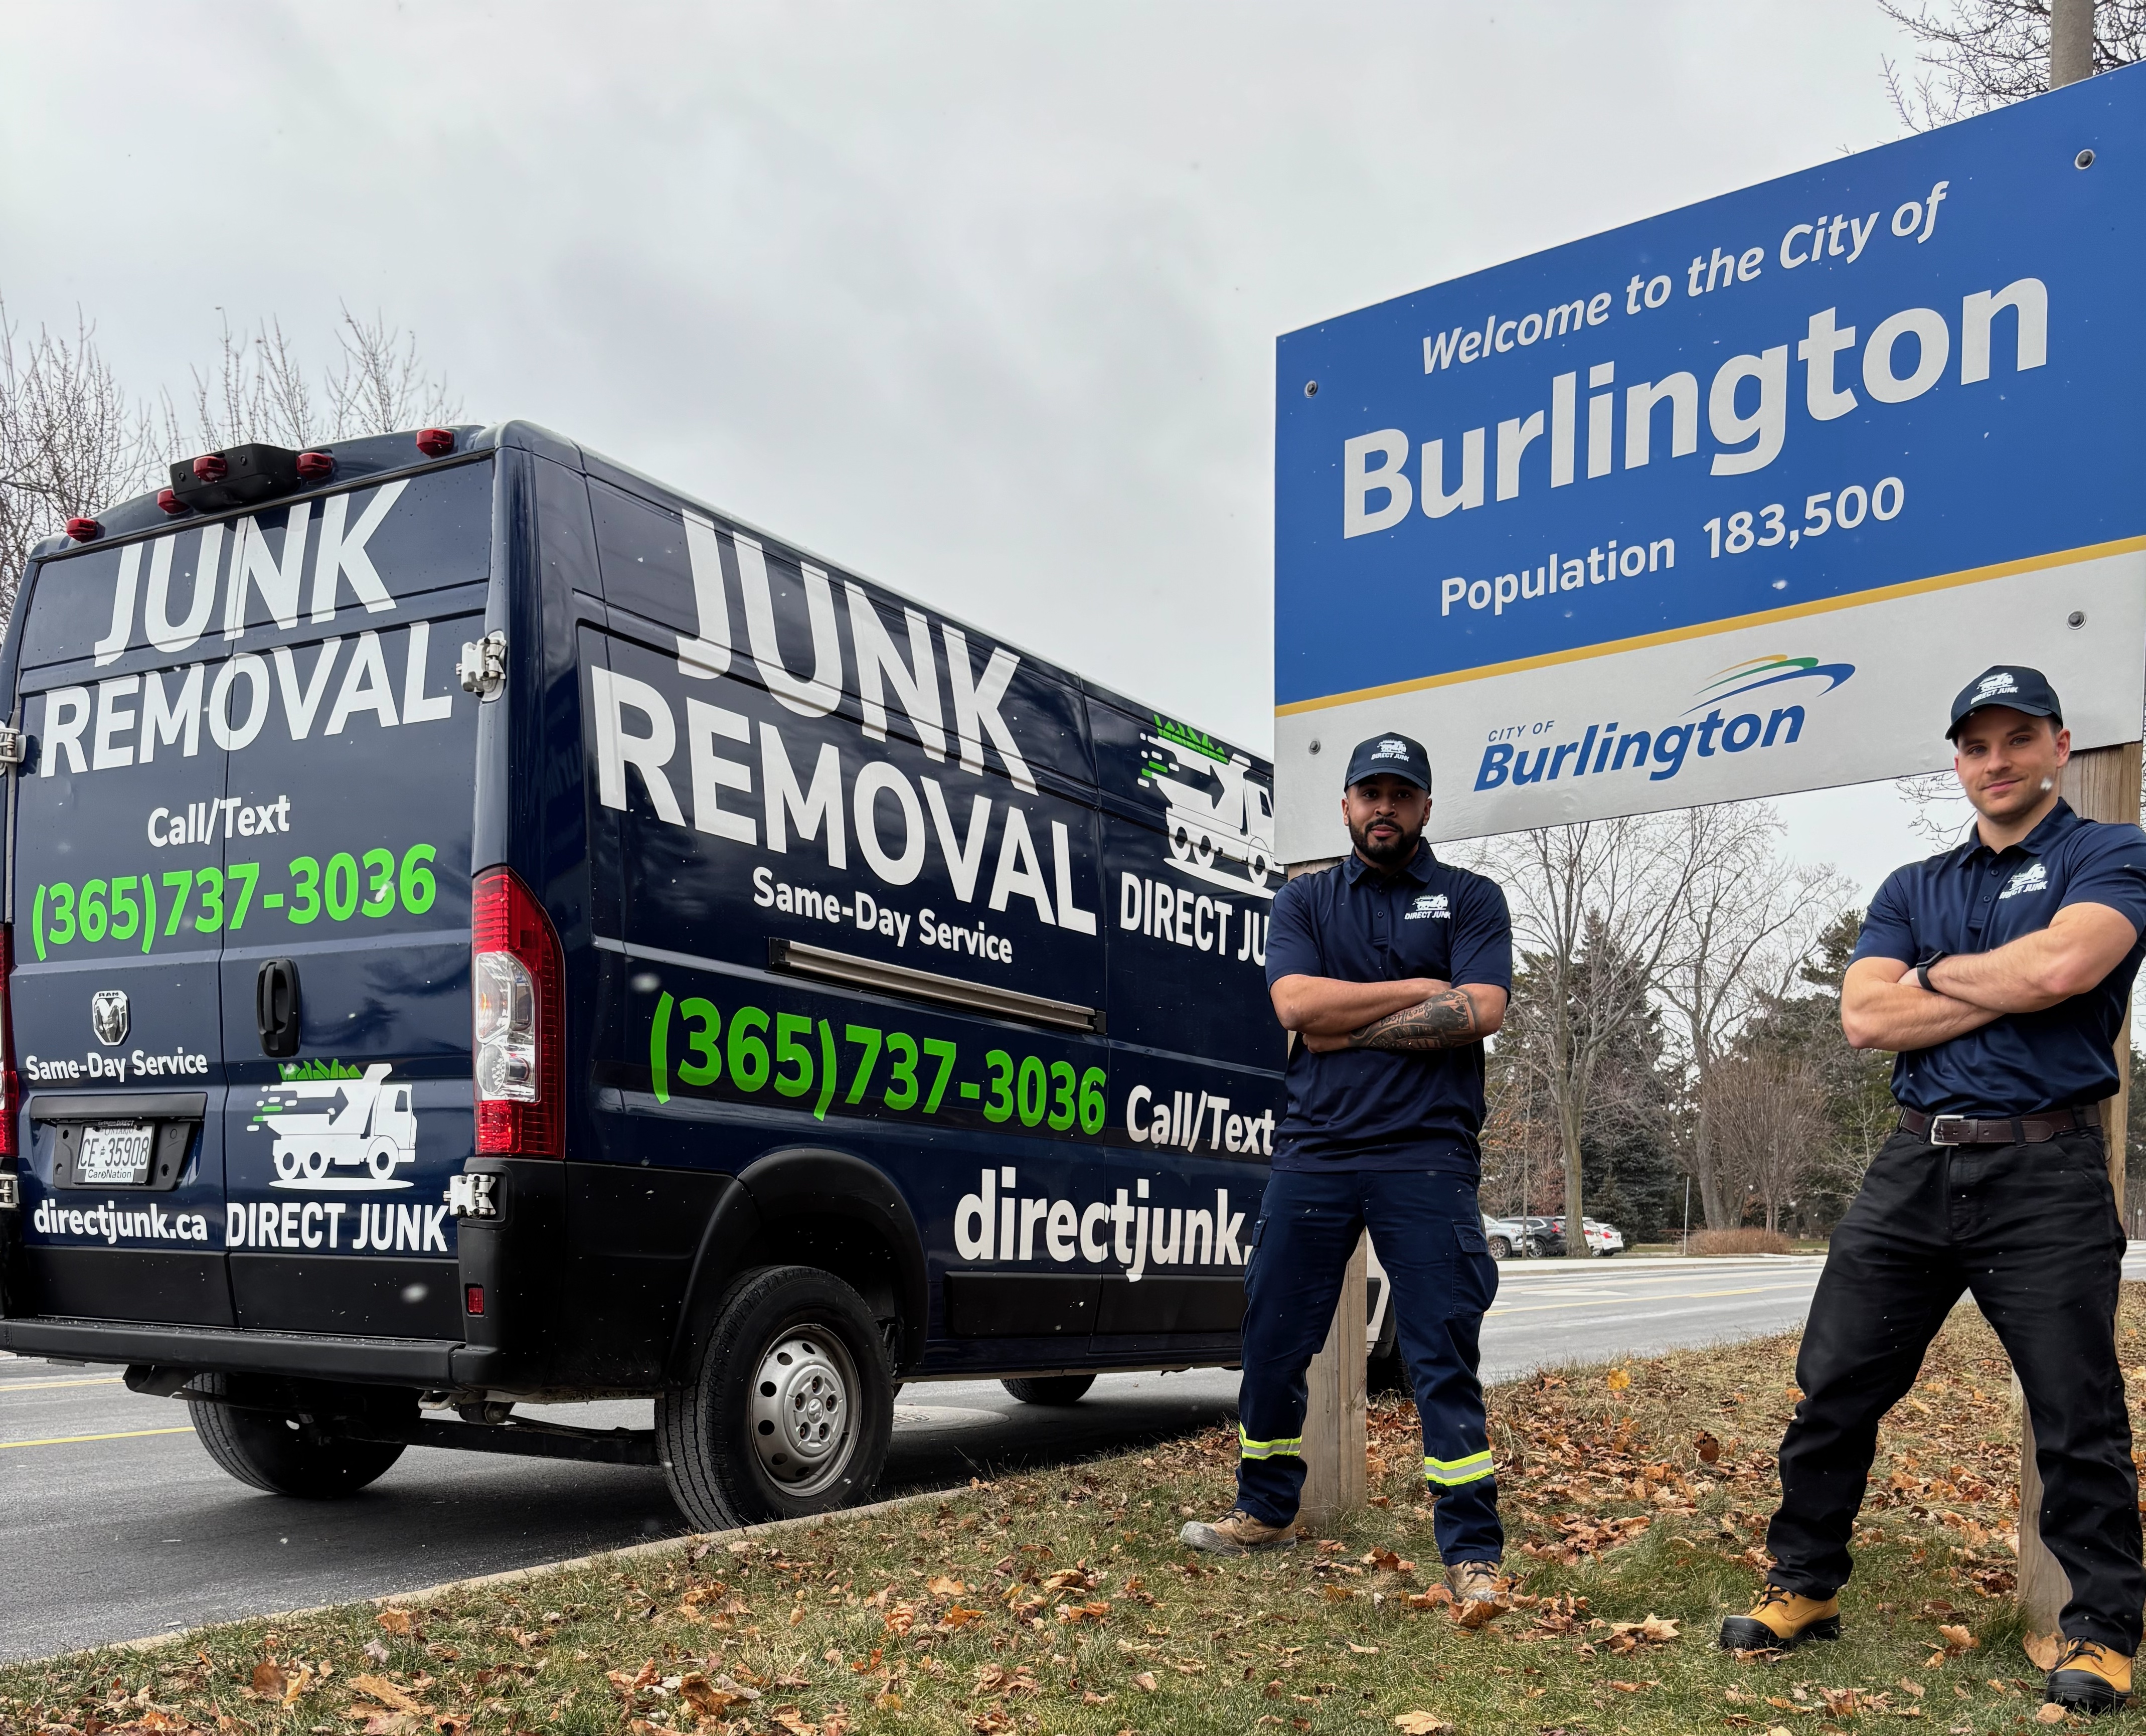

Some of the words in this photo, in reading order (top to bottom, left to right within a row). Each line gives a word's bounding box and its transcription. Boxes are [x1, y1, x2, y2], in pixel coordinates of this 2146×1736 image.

[1422, 293, 1611, 375] Welcome
[1627, 275, 1672, 315] to
[1688, 247, 1764, 297] the
[1779, 212, 1880, 269] City
[1891, 181, 1949, 244] of
[1344, 277, 2048, 539] Burlington
[94, 479, 411, 667] JUNK
[1442, 538, 1675, 617] Population
[1704, 477, 1904, 559] 183,500
[675, 508, 1040, 796] JUNK
[1997, 686, 2018, 694] JUNK
[41, 621, 452, 778] REMOVAL
[1488, 724, 1527, 742] CITY
[1533, 720, 1555, 735] OF
[1394, 753, 1410, 762] JUNK
[1473, 705, 1805, 792] Burlington
[147, 795, 290, 847] Call/Text
[591, 665, 1097, 936] REMOVAL
[32, 844, 436, 962] (365)737-3036
[753, 866, 911, 947] Same-Day
[919, 907, 1013, 964] Service
[1120, 871, 1233, 956] DIRECT
[1237, 909, 1270, 967] JU
[1404, 911, 1432, 919] DIRECT
[1431, 911, 1451, 919] JUNK
[2023, 881, 2048, 892] JUNK
[26, 1052, 126, 1082] Same-Day
[131, 1047, 208, 1075] Service
[650, 991, 1107, 1135] (365)737-3036
[105, 1136, 149, 1167] 35908
[1126, 1084, 1275, 1156] Call/Text
[34, 1199, 208, 1244] directjunk.ca
[226, 1202, 346, 1248] DIRECT
[353, 1203, 449, 1251] JUNK
[954, 1166, 1254, 1283] directjunk.
